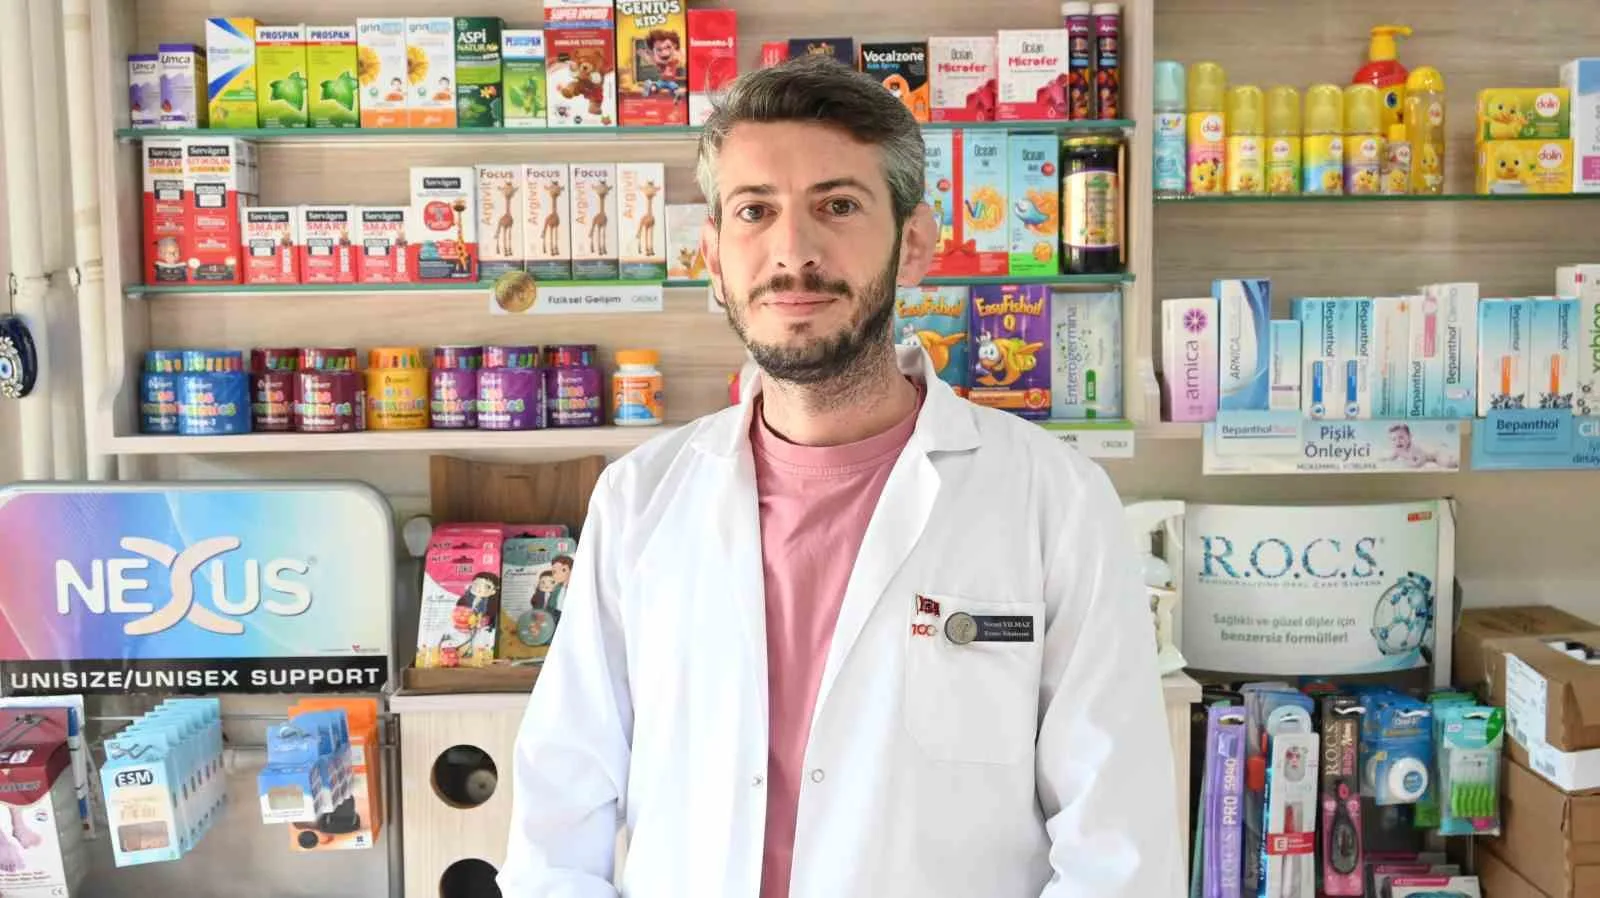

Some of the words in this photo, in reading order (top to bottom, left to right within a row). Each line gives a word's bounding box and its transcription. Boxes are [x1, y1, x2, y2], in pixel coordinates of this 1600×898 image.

[622, 0, 680, 14] GENIUS
[635, 13, 667, 28] KIDS
[260, 31, 299, 39] PROSPAN
[310, 31, 350, 39] PROSPAN
[863, 51, 924, 62] Vocalzone
[1008, 56, 1059, 68] Microfer
[937, 63, 987, 73] Microfer
[480, 168, 514, 178] Focus
[526, 168, 560, 178] Focus
[574, 168, 608, 178] Focus
[1325, 301, 1337, 357] Bepanthol
[1360, 301, 1370, 357] Bepanthol
[1065, 305, 1082, 406] Enterogermina
[1230, 338, 1241, 380] ARNICA
[1446, 326, 1457, 385] Bepanthol
[1184, 340, 1201, 400] arnica
[1410, 361, 1422, 416] Bepanthol
[1222, 424, 1271, 435] Bepanthol
[1496, 417, 1559, 432] Bepanthol
[1320, 425, 1356, 441] Pişik
[1304, 443, 1371, 461] Önleyici
[1198, 535, 1385, 579] R.O.C.S.
[55, 536, 314, 635] NEXUS
[1256, 617, 1270, 625] ve
[1272, 614, 1303, 628] güzel
[1304, 615, 1335, 628] dişler
[1337, 615, 1356, 628] için
[1220, 630, 1282, 642] benzersiz
[1285, 630, 1348, 643] formüller!
[11, 669, 240, 690] UNISIZE/UNISEX
[251, 667, 381, 687] SUPPORT
[117, 771, 152, 787] ESM
[1222, 795, 1238, 826] PRO
